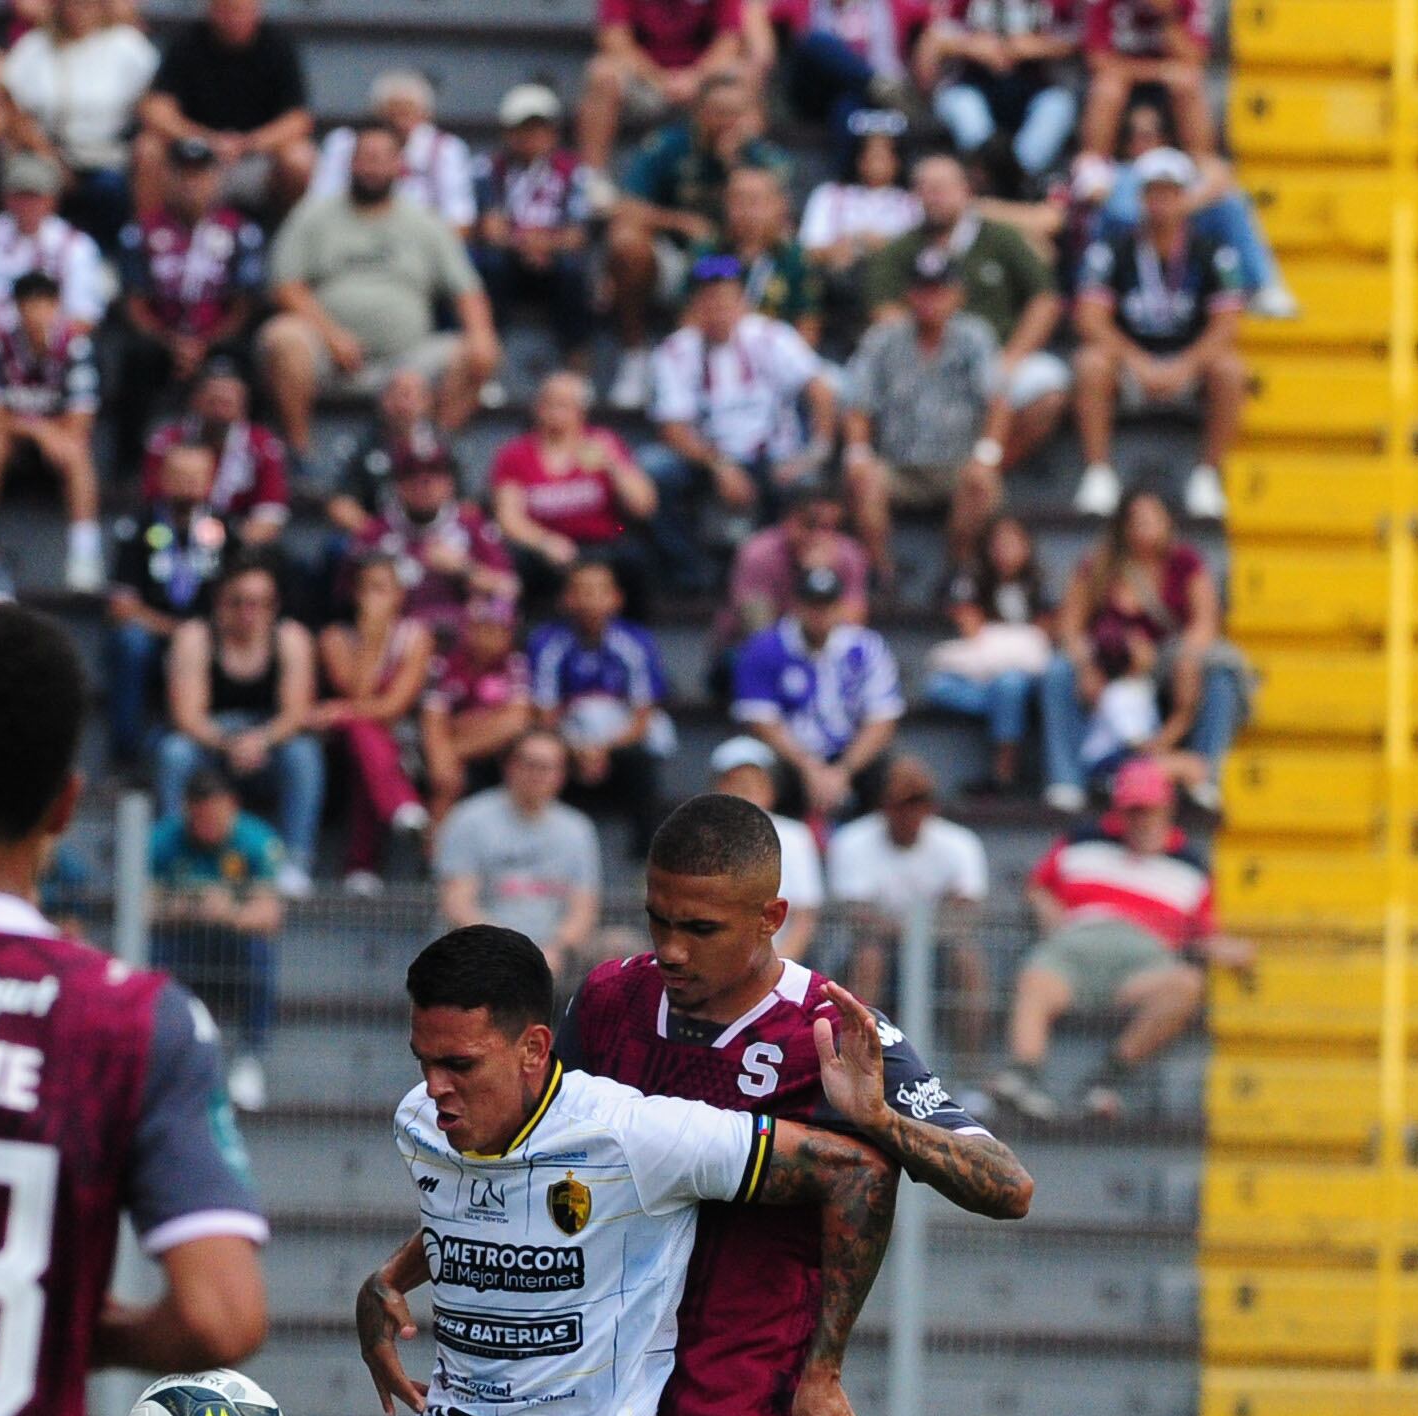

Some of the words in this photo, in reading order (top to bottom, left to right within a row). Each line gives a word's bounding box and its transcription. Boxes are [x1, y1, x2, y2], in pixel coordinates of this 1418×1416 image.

[737, 1042, 784, 1097] S
[443, 1240, 579, 1271] METROCOM
[442, 1263, 454, 1279] El
[457, 1266, 500, 1288] Mejor
[504, 1271, 579, 1288] Internet
[470, 1324, 569, 1344] BATERIAS
